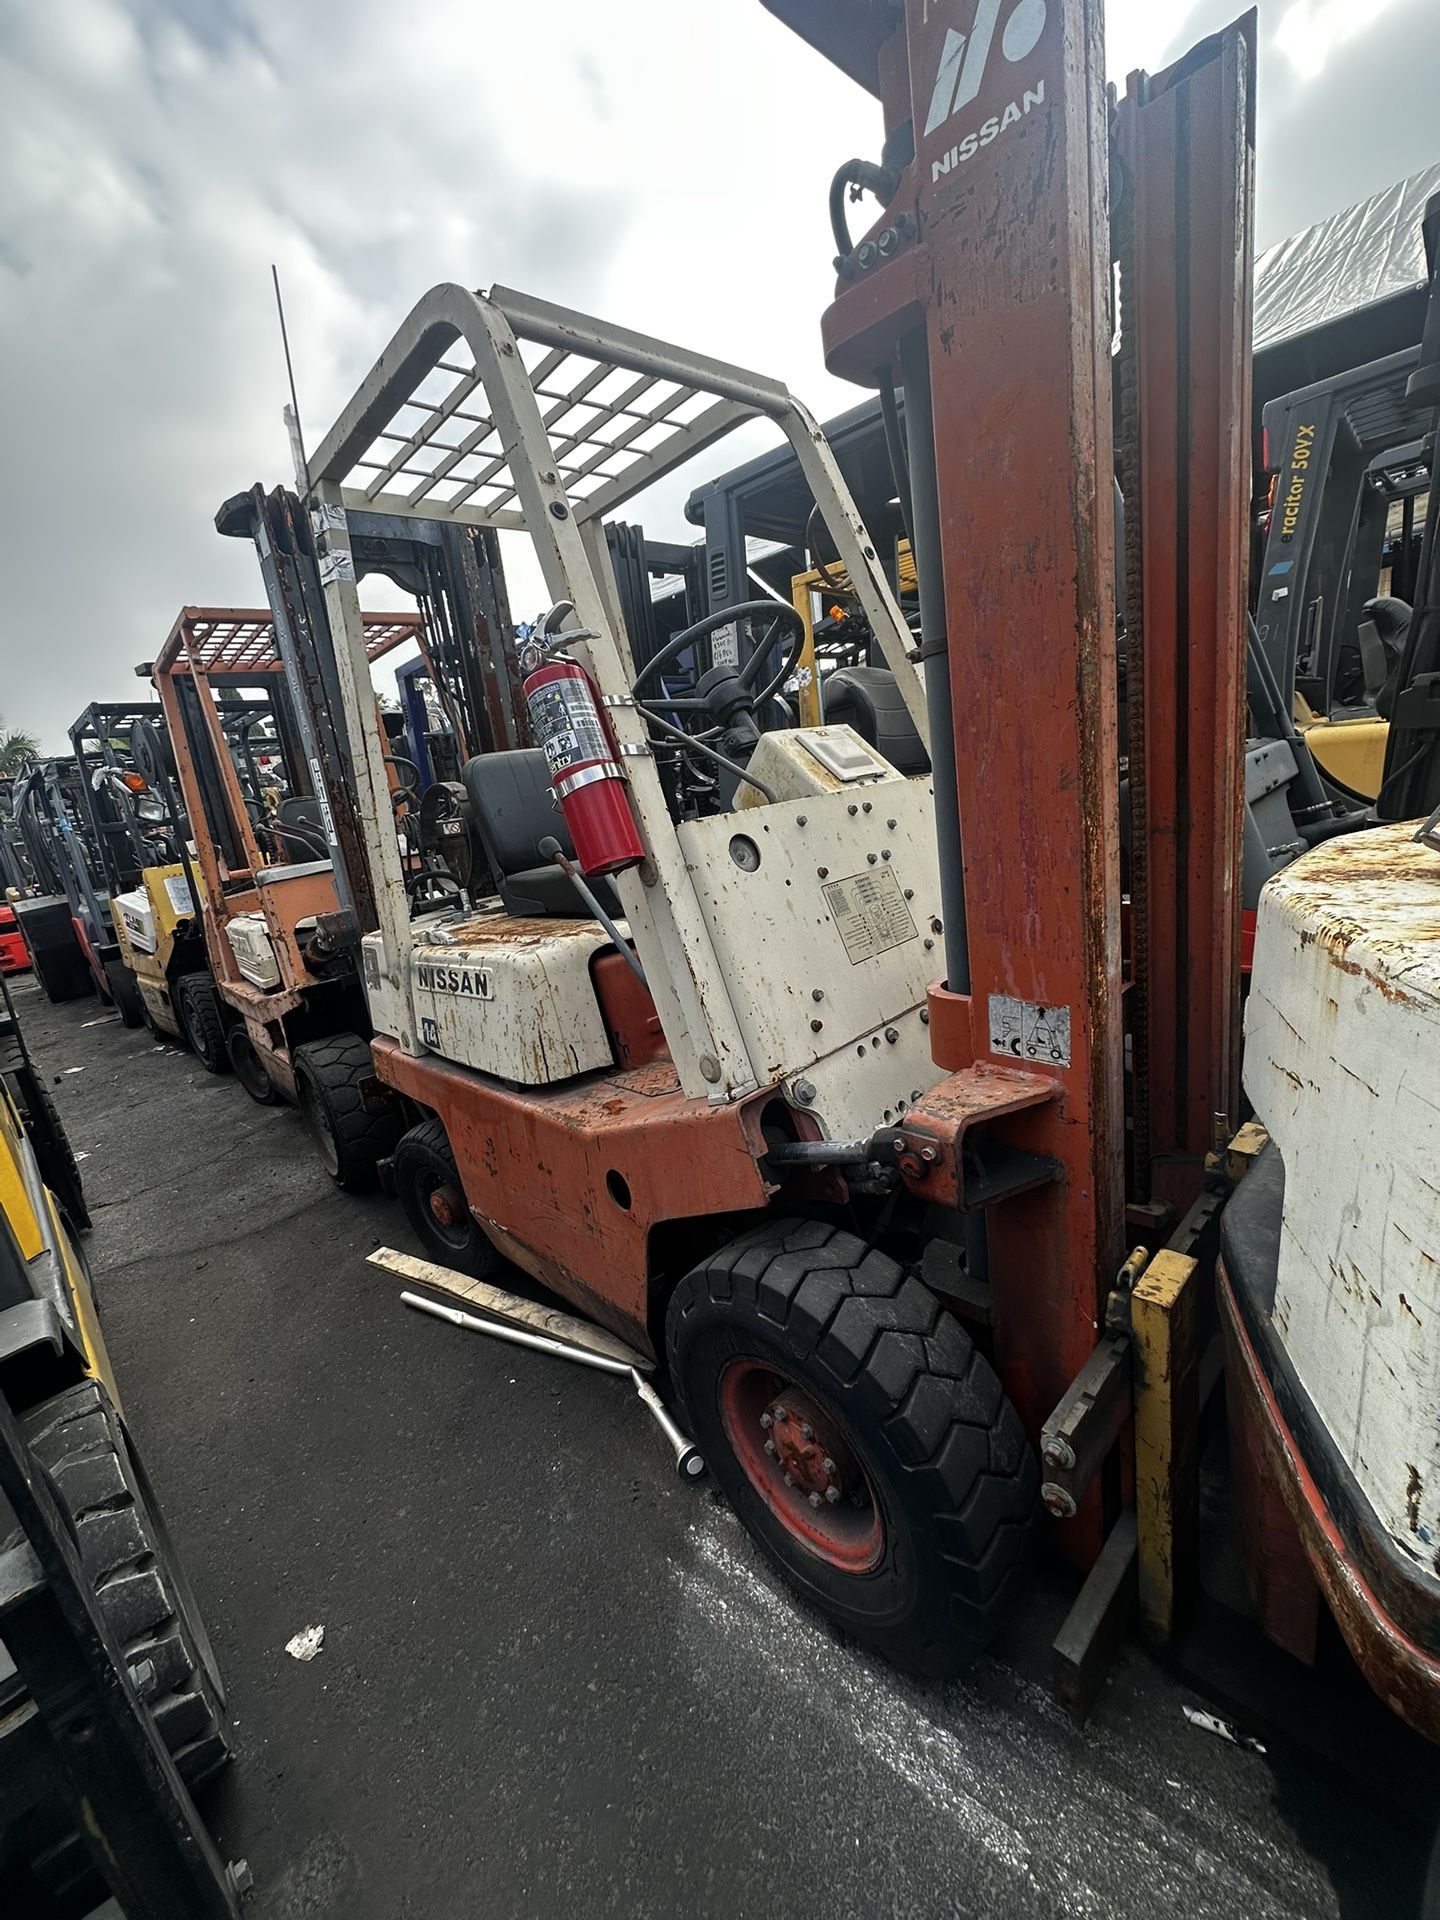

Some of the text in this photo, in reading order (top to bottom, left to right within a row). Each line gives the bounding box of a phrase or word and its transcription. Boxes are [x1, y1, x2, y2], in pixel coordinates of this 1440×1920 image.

[931, 80, 1045, 183] NISSAN
[1280, 424, 1316, 544] eracitor 50VX
[417, 966, 488, 998] NISSAN
[424, 1021, 439, 1046] 14
